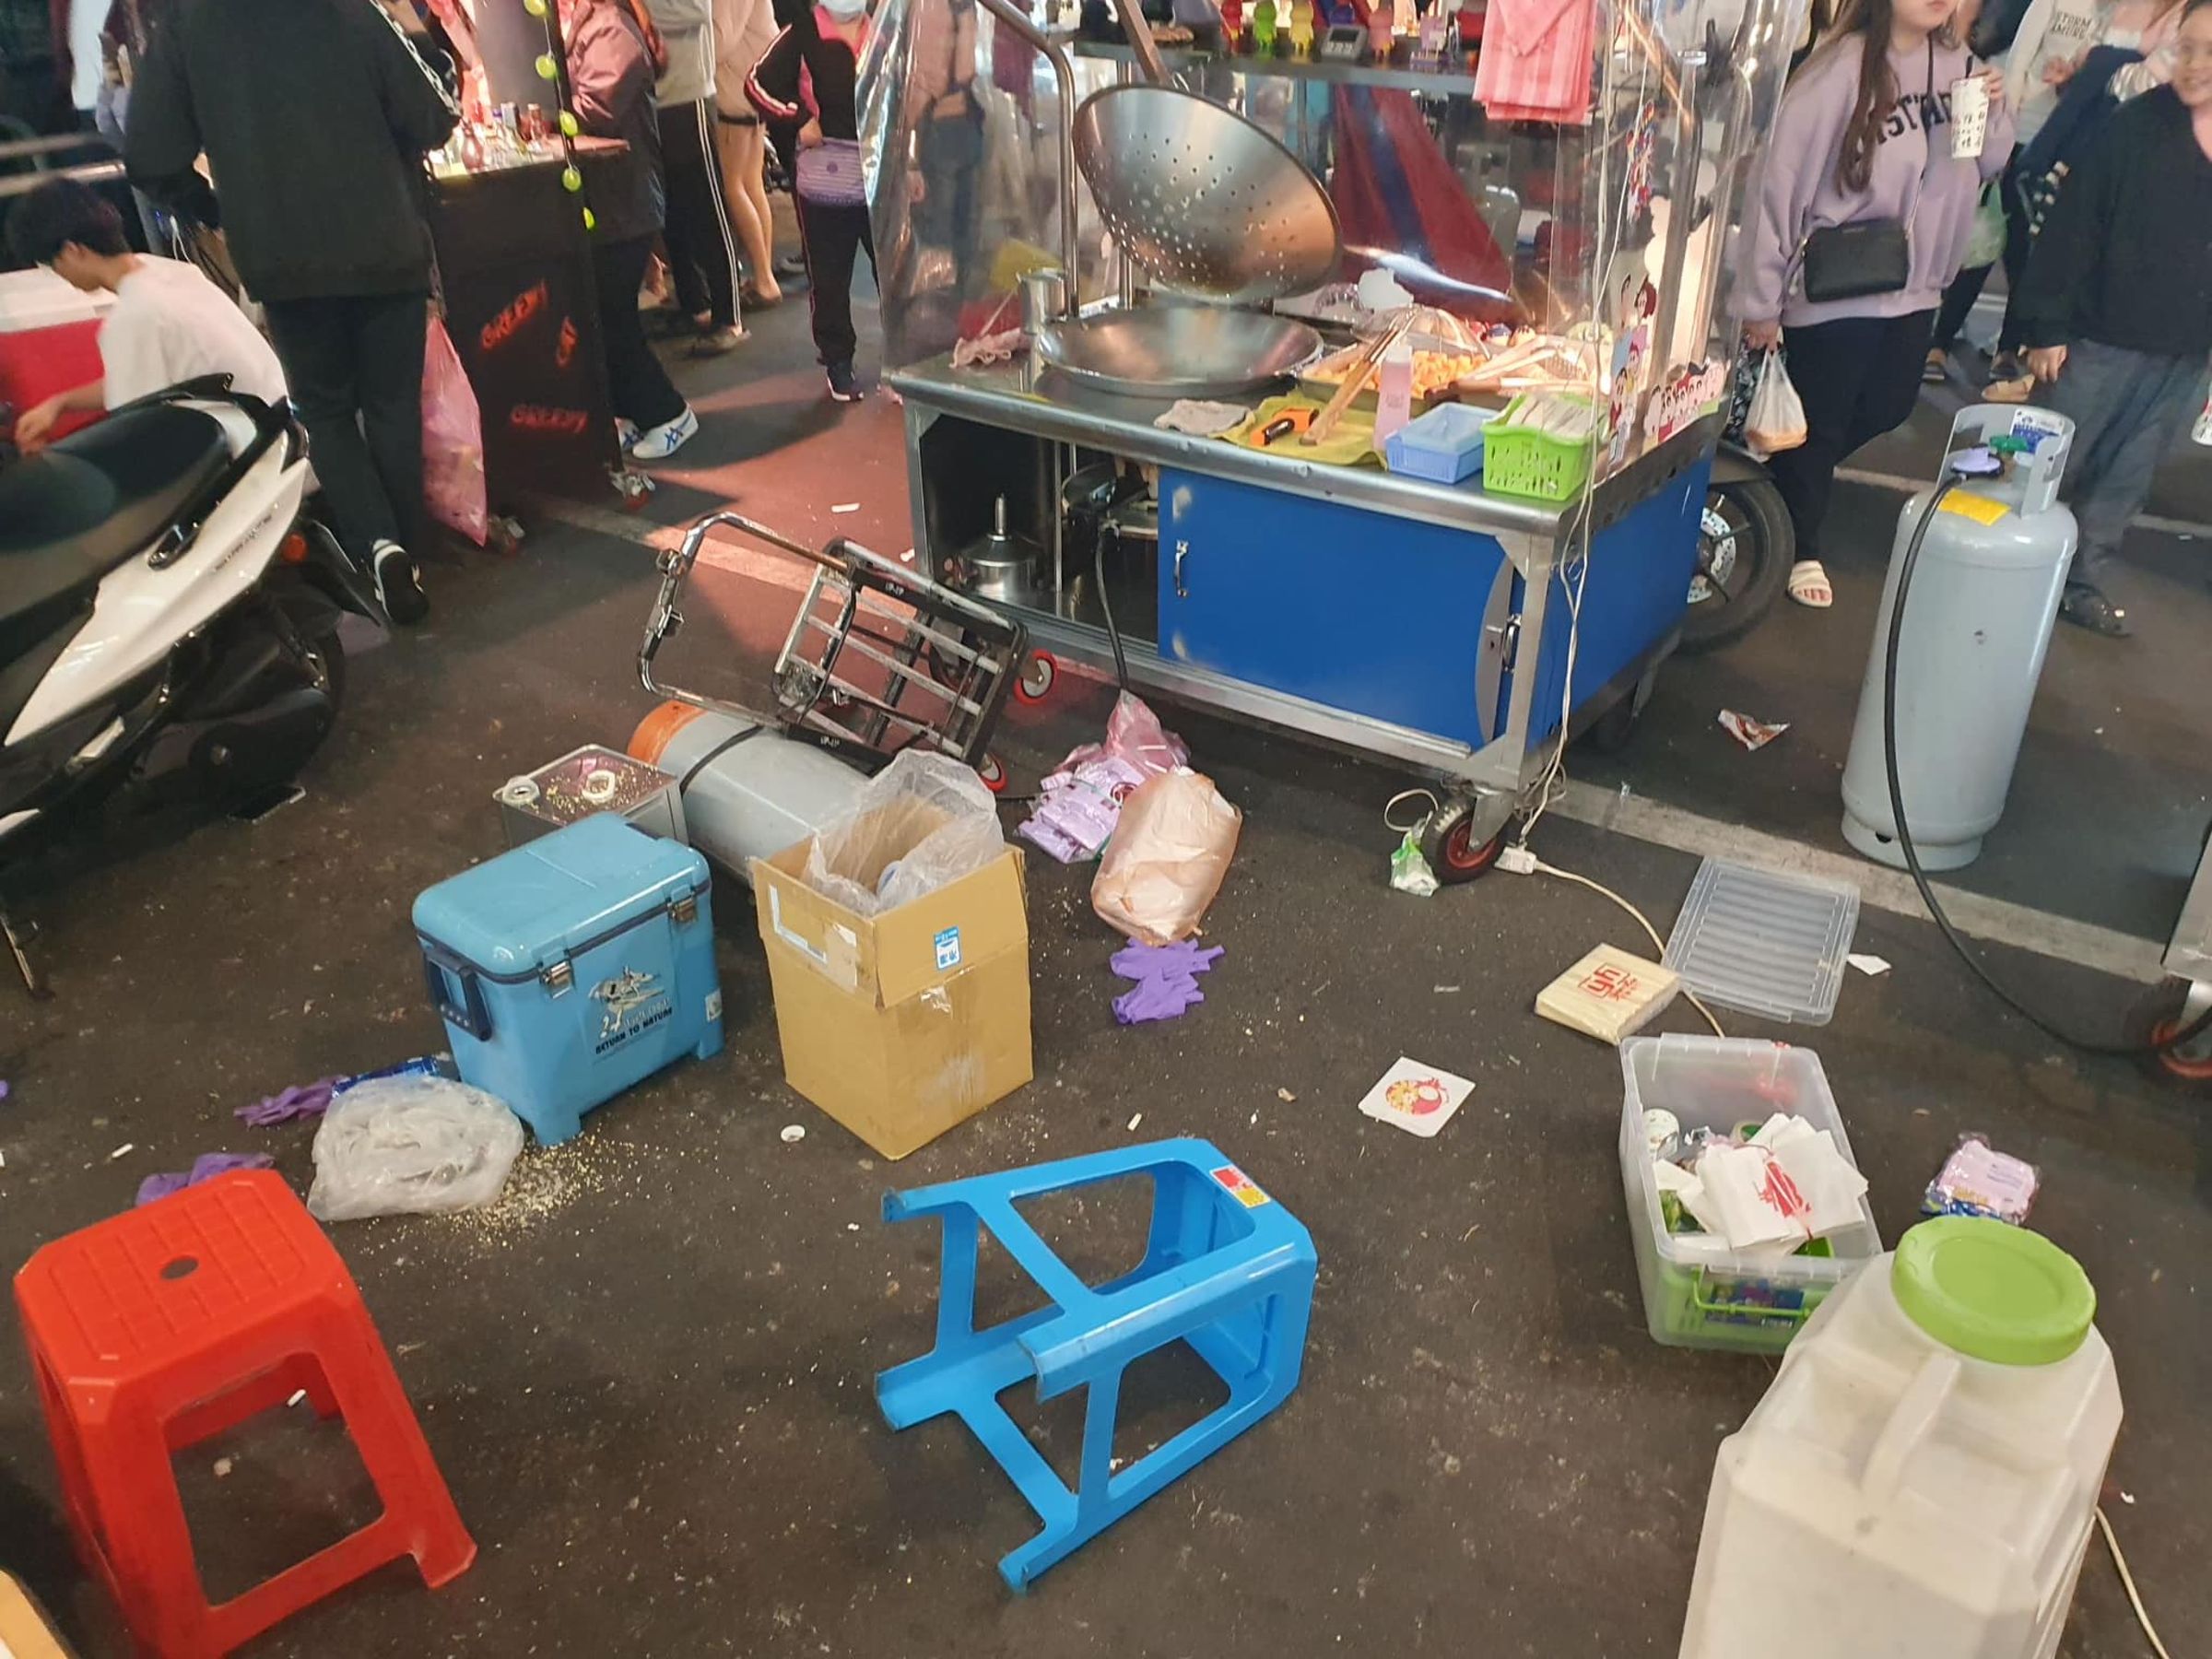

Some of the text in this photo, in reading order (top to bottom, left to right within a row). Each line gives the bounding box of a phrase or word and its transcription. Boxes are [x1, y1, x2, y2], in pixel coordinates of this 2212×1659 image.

[595, 1031, 626, 1054] RETURN
[629, 1024, 641, 1036] TO
[642, 1006, 673, 1029] NATURE
